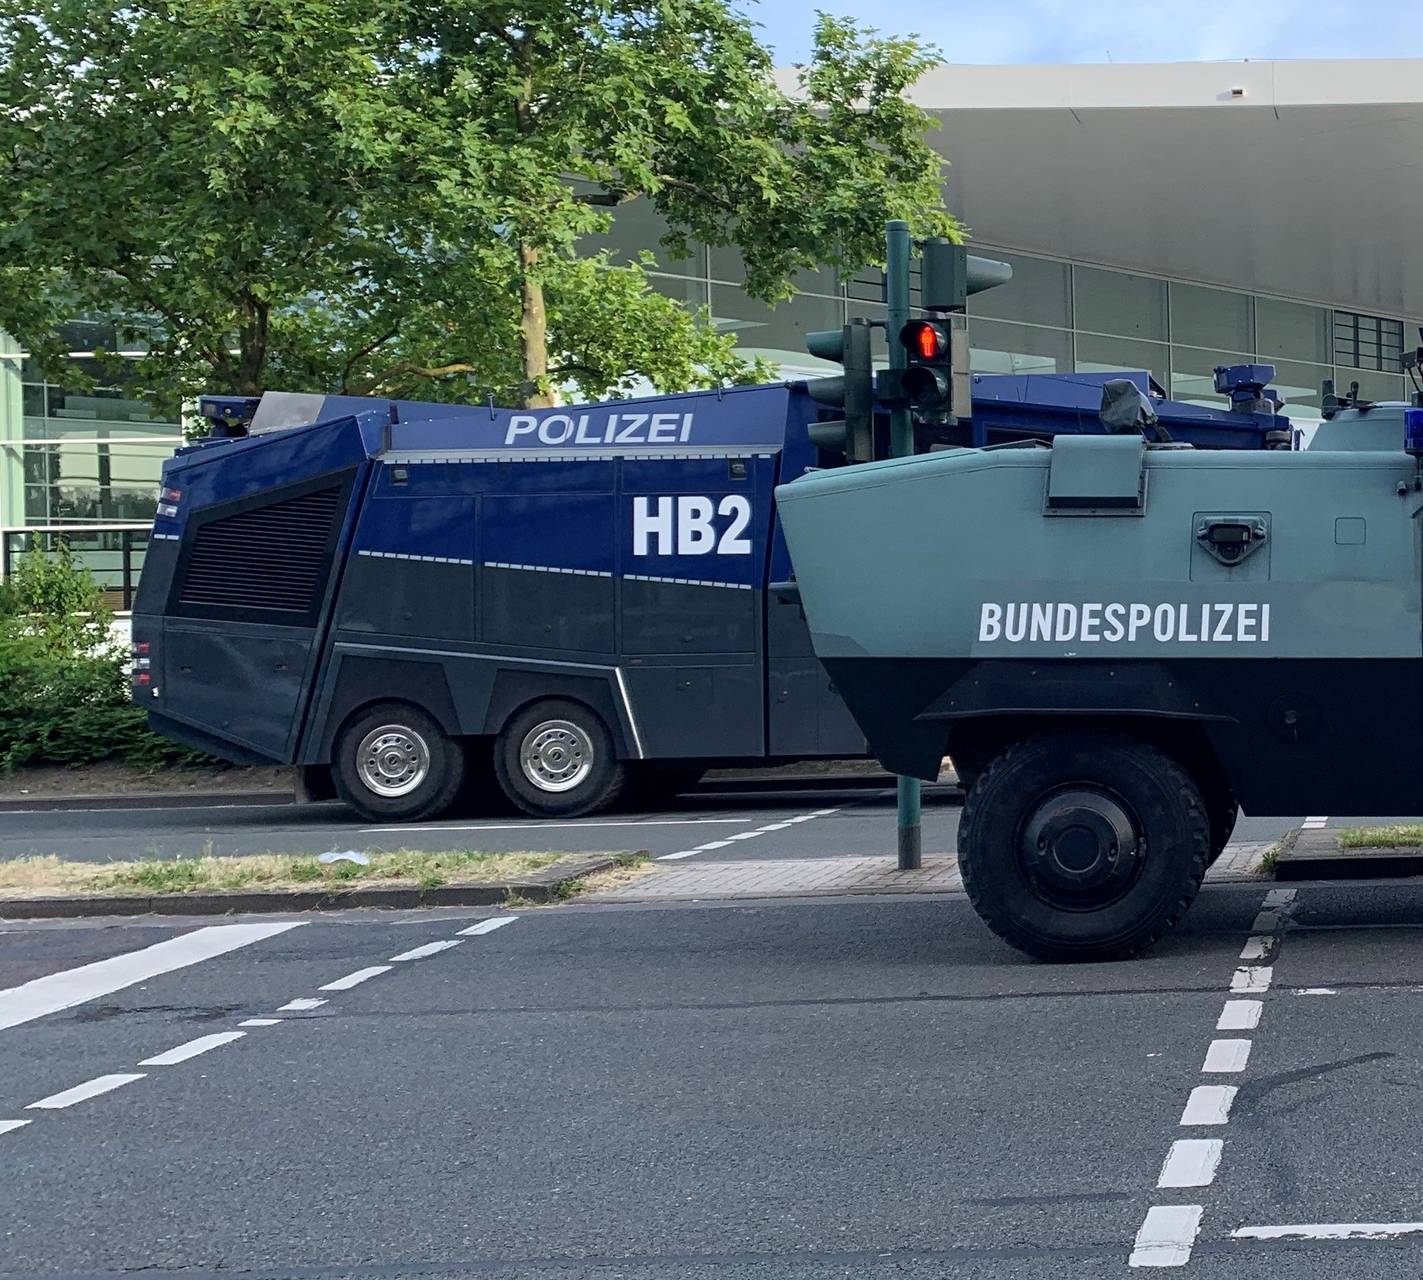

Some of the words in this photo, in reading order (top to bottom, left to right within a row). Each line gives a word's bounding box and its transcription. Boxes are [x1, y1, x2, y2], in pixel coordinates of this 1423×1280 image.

[505, 413, 693, 444] POLIZEI
[633, 495, 751, 556] HB2
[979, 603, 1270, 642] BUNDESPOLIZEI
